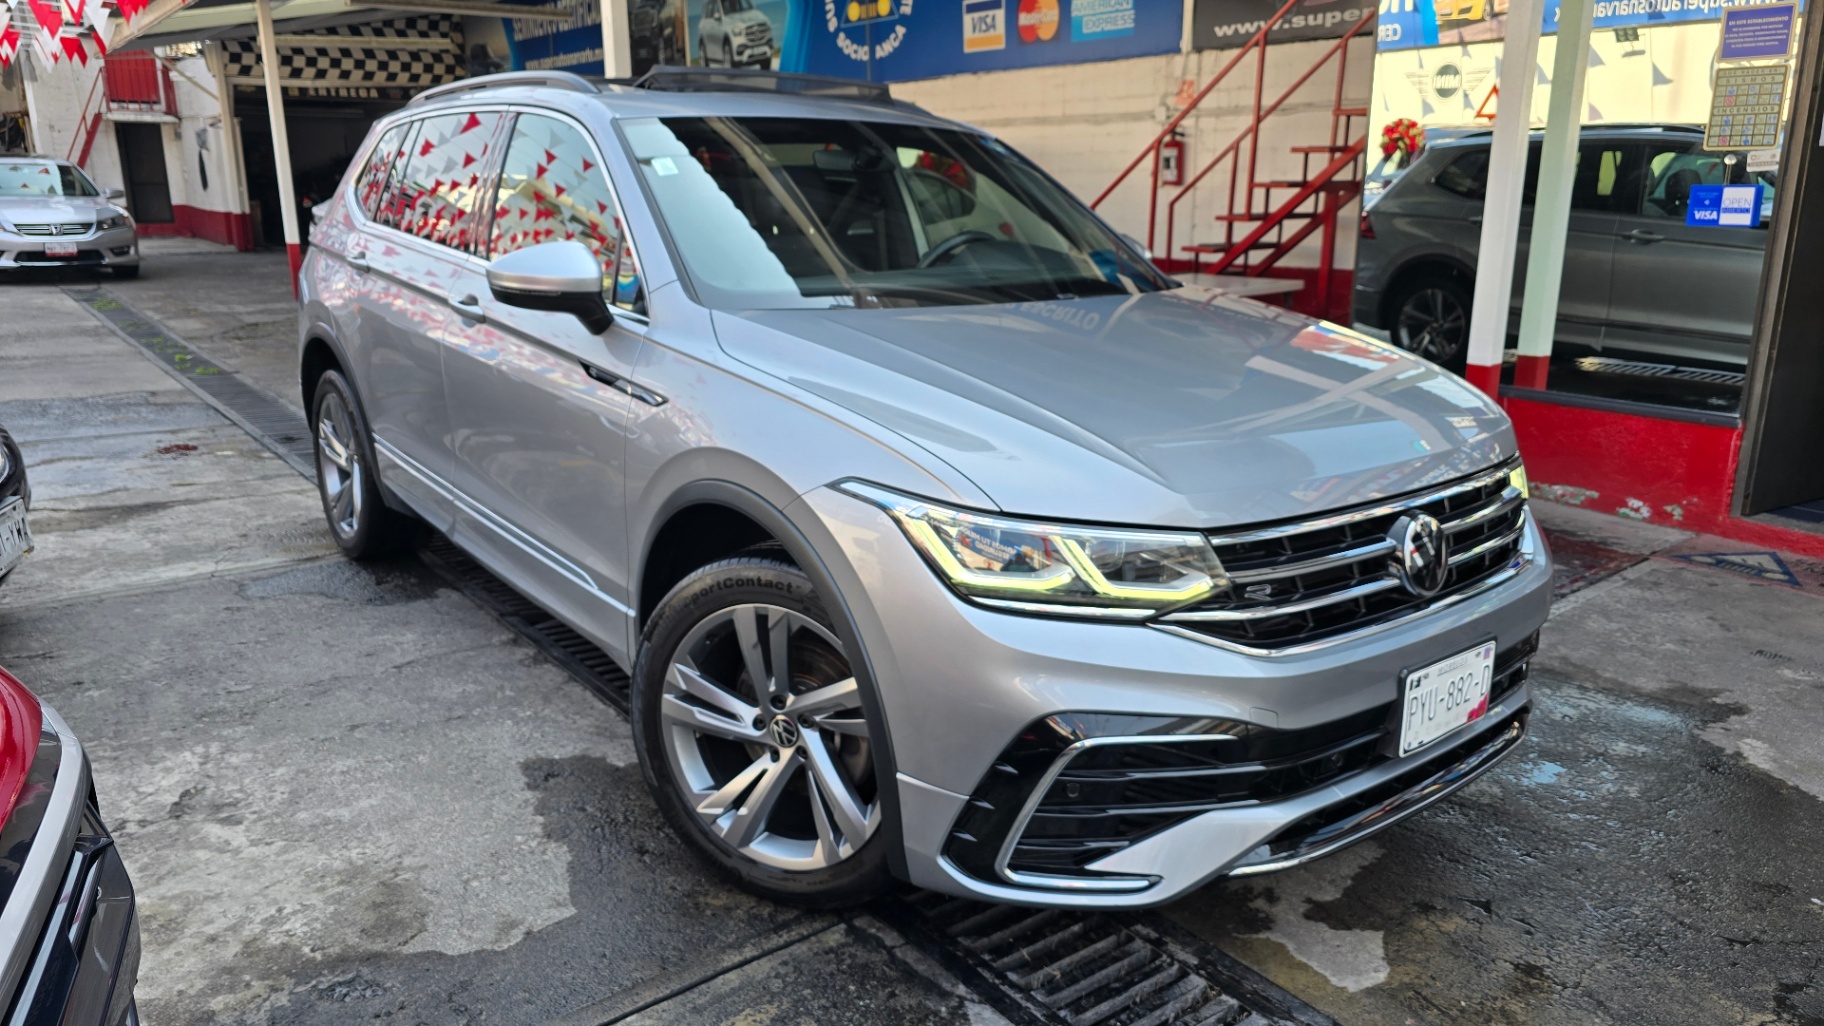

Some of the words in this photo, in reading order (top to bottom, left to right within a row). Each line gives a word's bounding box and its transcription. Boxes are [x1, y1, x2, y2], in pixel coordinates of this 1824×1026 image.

[971, 13, 998, 35] VISA
[1083, 13, 1135, 33] EXPRESS
[836, 31, 870, 62] SOCIO
[875, 24, 907, 60] ANCA
[1717, 106, 1775, 114] INCENDIOS
[1722, 197, 1752, 207] OPEN
[1693, 210, 1718, 220] VISA
[1407, 664, 1491, 731] PYU-882-D
